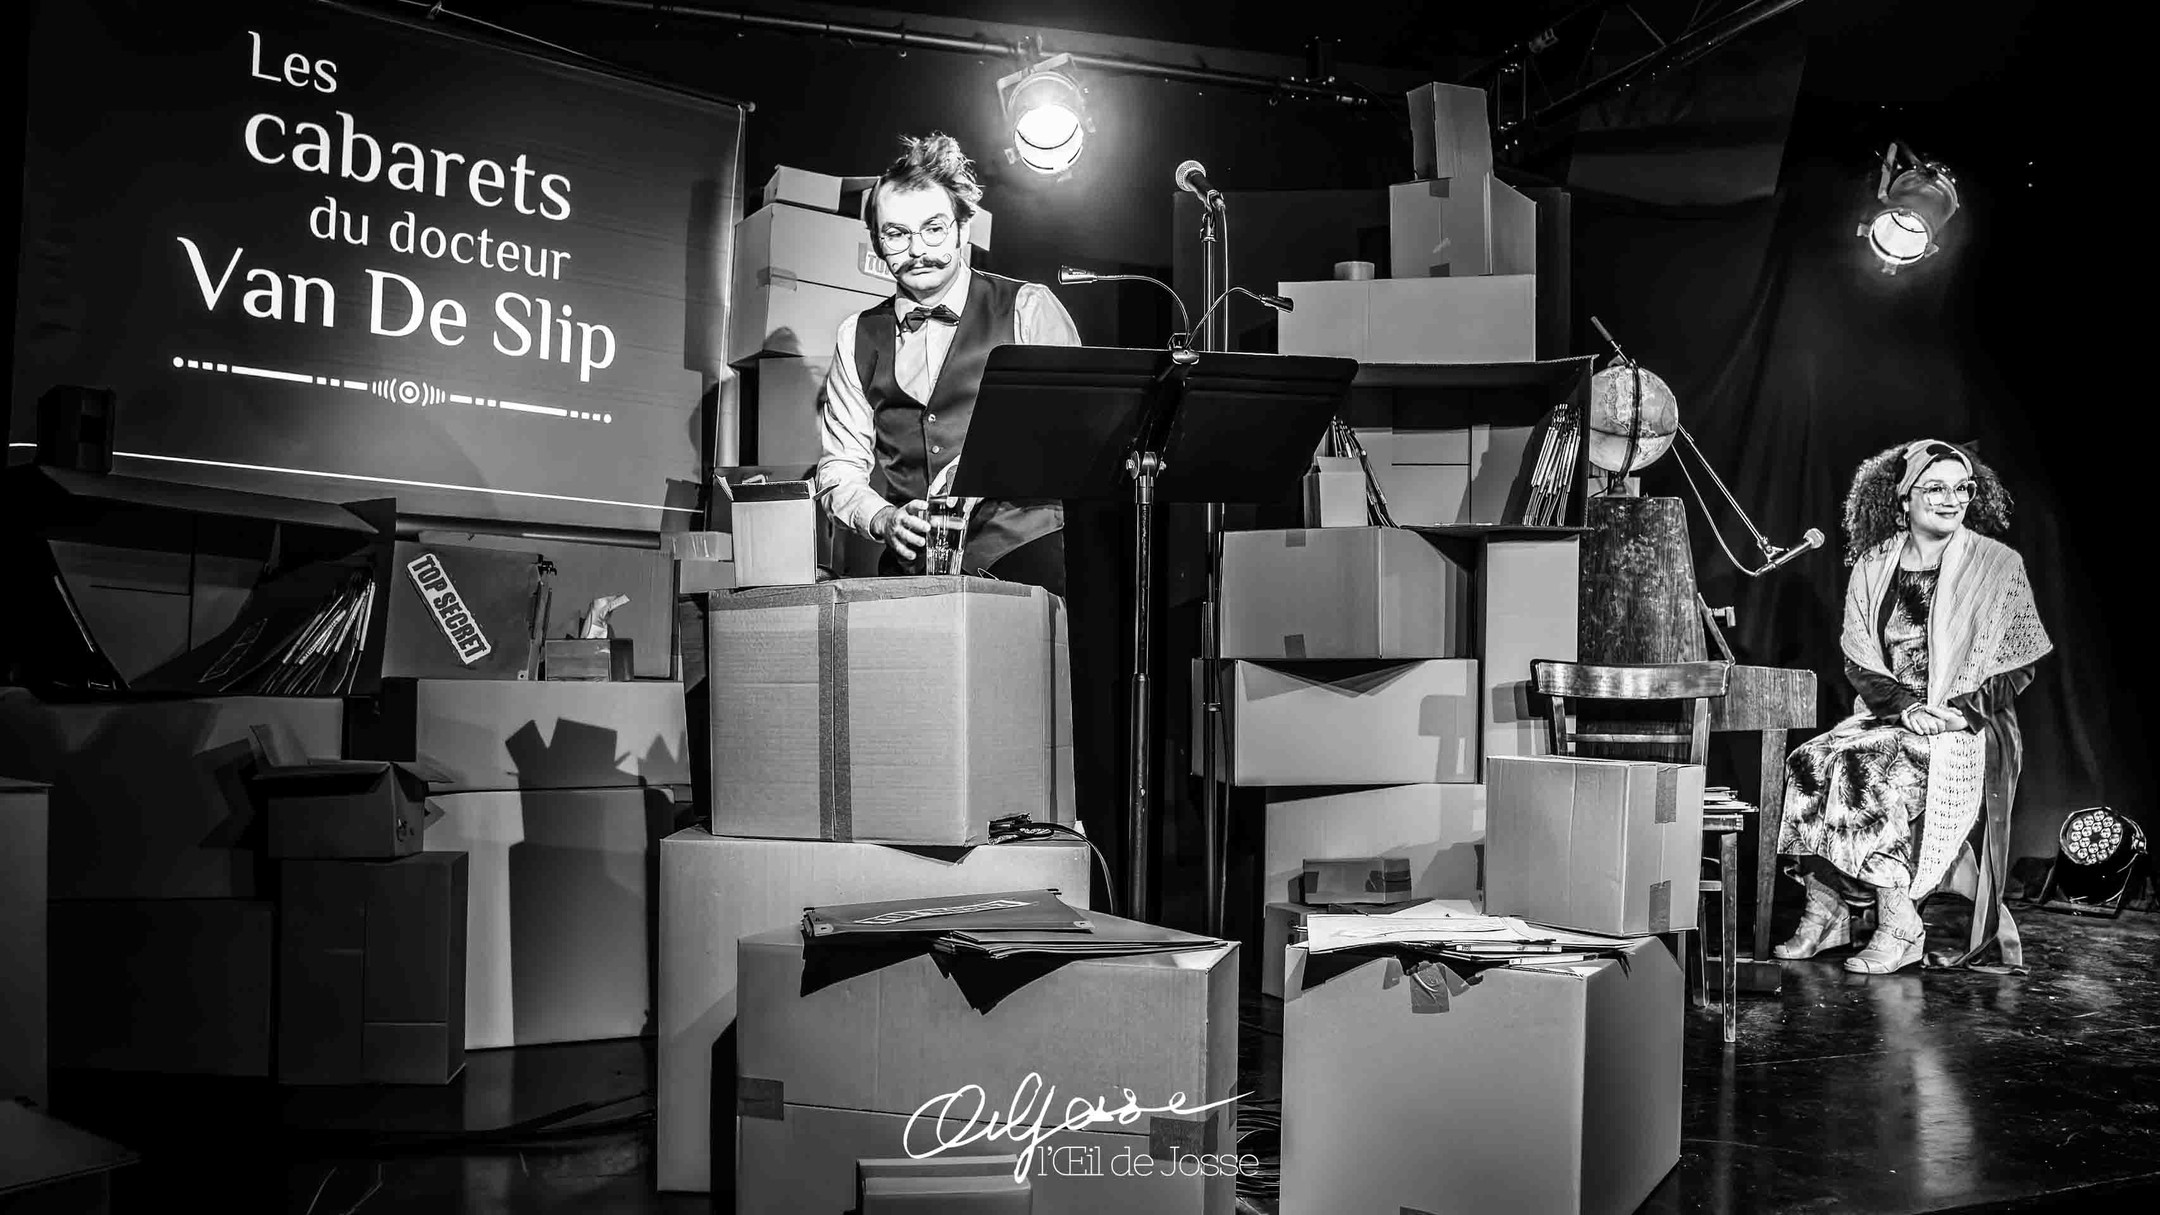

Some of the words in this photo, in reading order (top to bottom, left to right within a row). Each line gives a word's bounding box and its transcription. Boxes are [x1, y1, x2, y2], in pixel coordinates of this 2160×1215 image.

[248, 30, 337, 93] Les
[245, 110, 572, 221] cabarets
[309, 195, 369, 246] du
[389, 211, 572, 281] docteur
[176, 236, 336, 328] Van
[364, 268, 467, 347] De
[492, 291, 616, 383] Slip
[411, 554, 449, 592] TOP
[432, 591, 488, 658] SECRET
